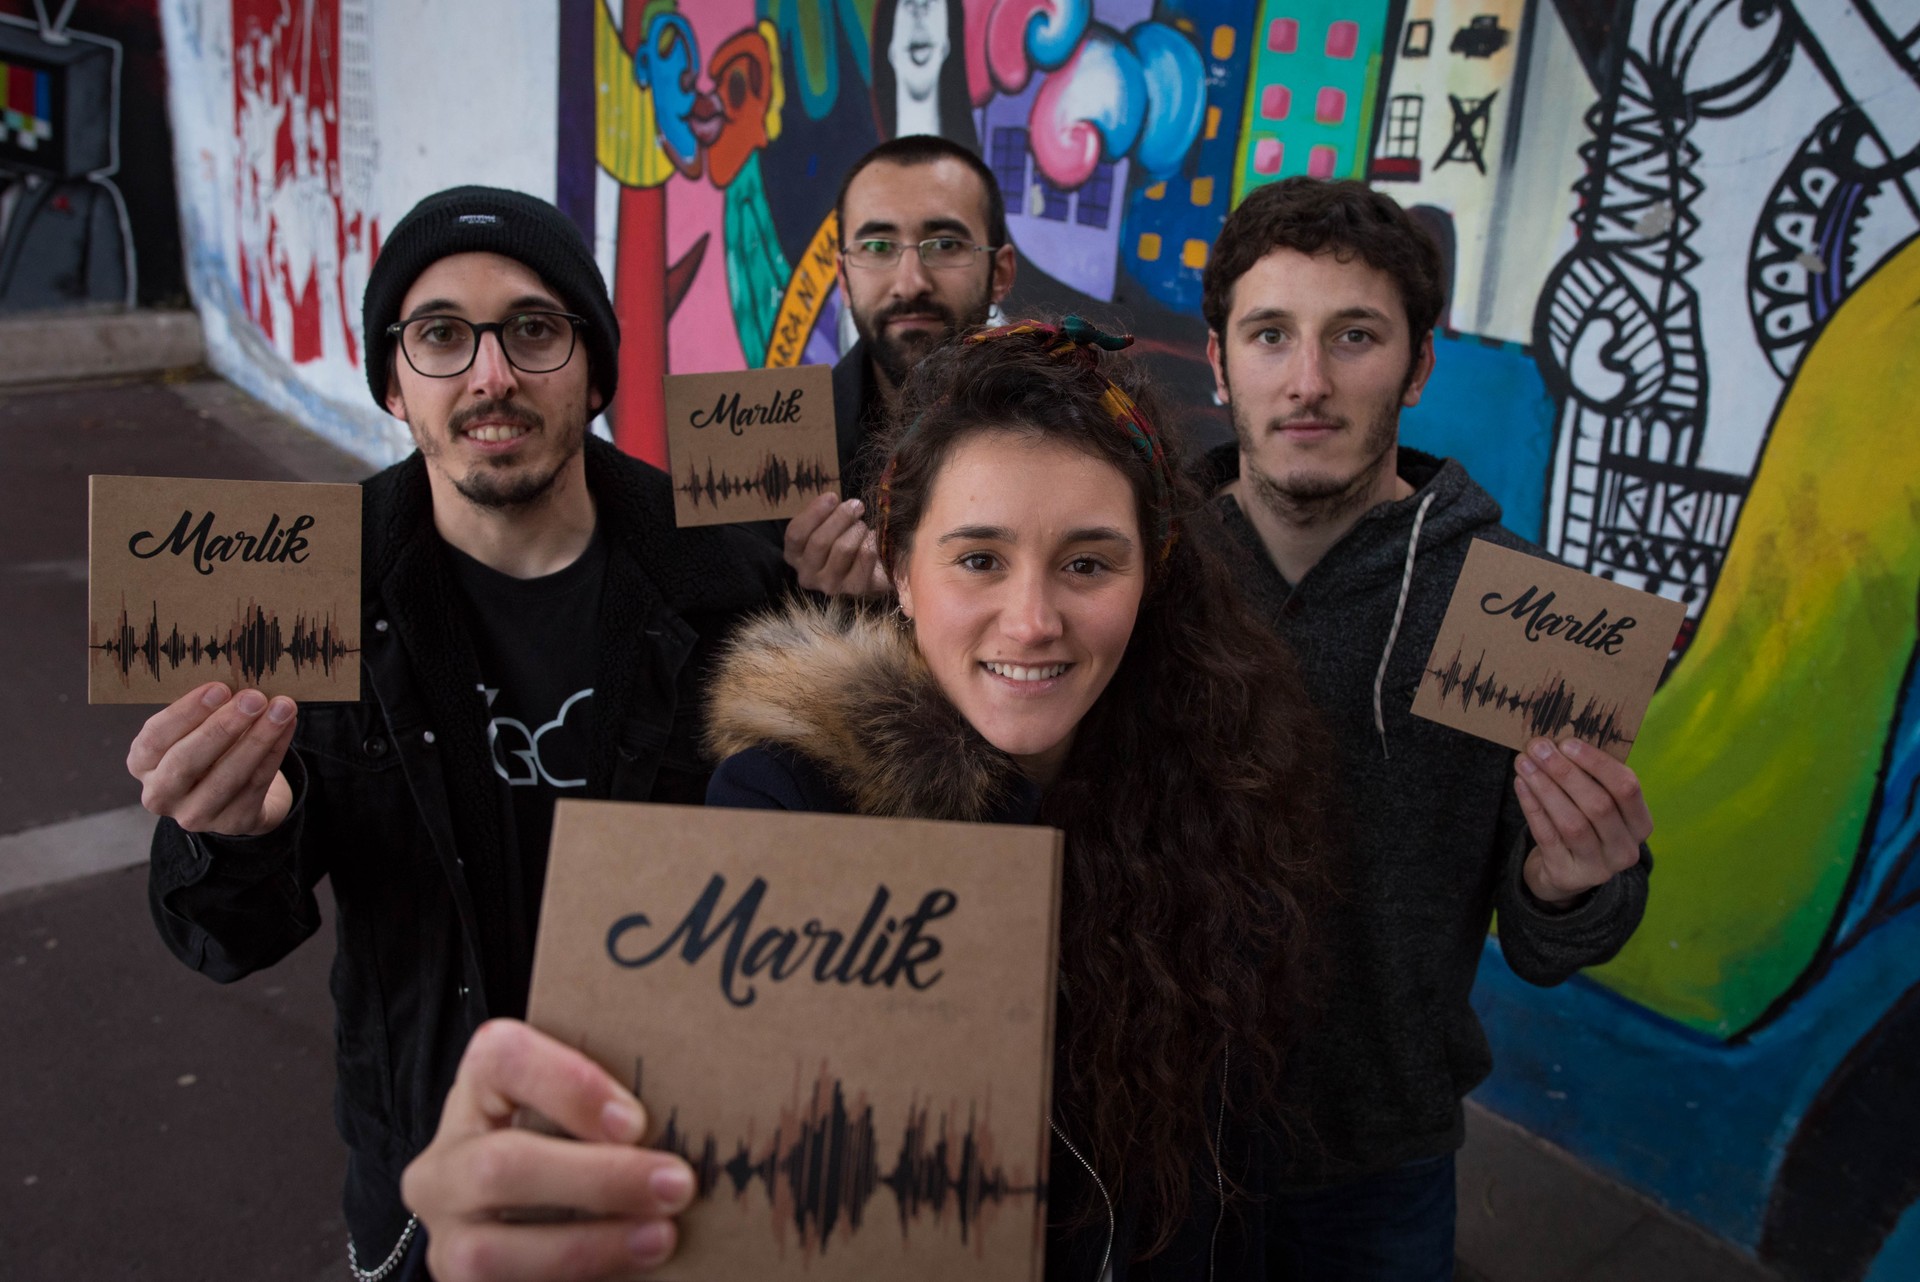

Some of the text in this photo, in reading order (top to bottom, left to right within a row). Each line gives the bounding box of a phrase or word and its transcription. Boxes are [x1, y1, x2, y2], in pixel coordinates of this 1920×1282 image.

[690, 388, 804, 436] Marlik
[128, 510, 315, 576] Marlik
[1480, 585, 1637, 655] Marlik
[606, 873, 958, 1007] Marlik
